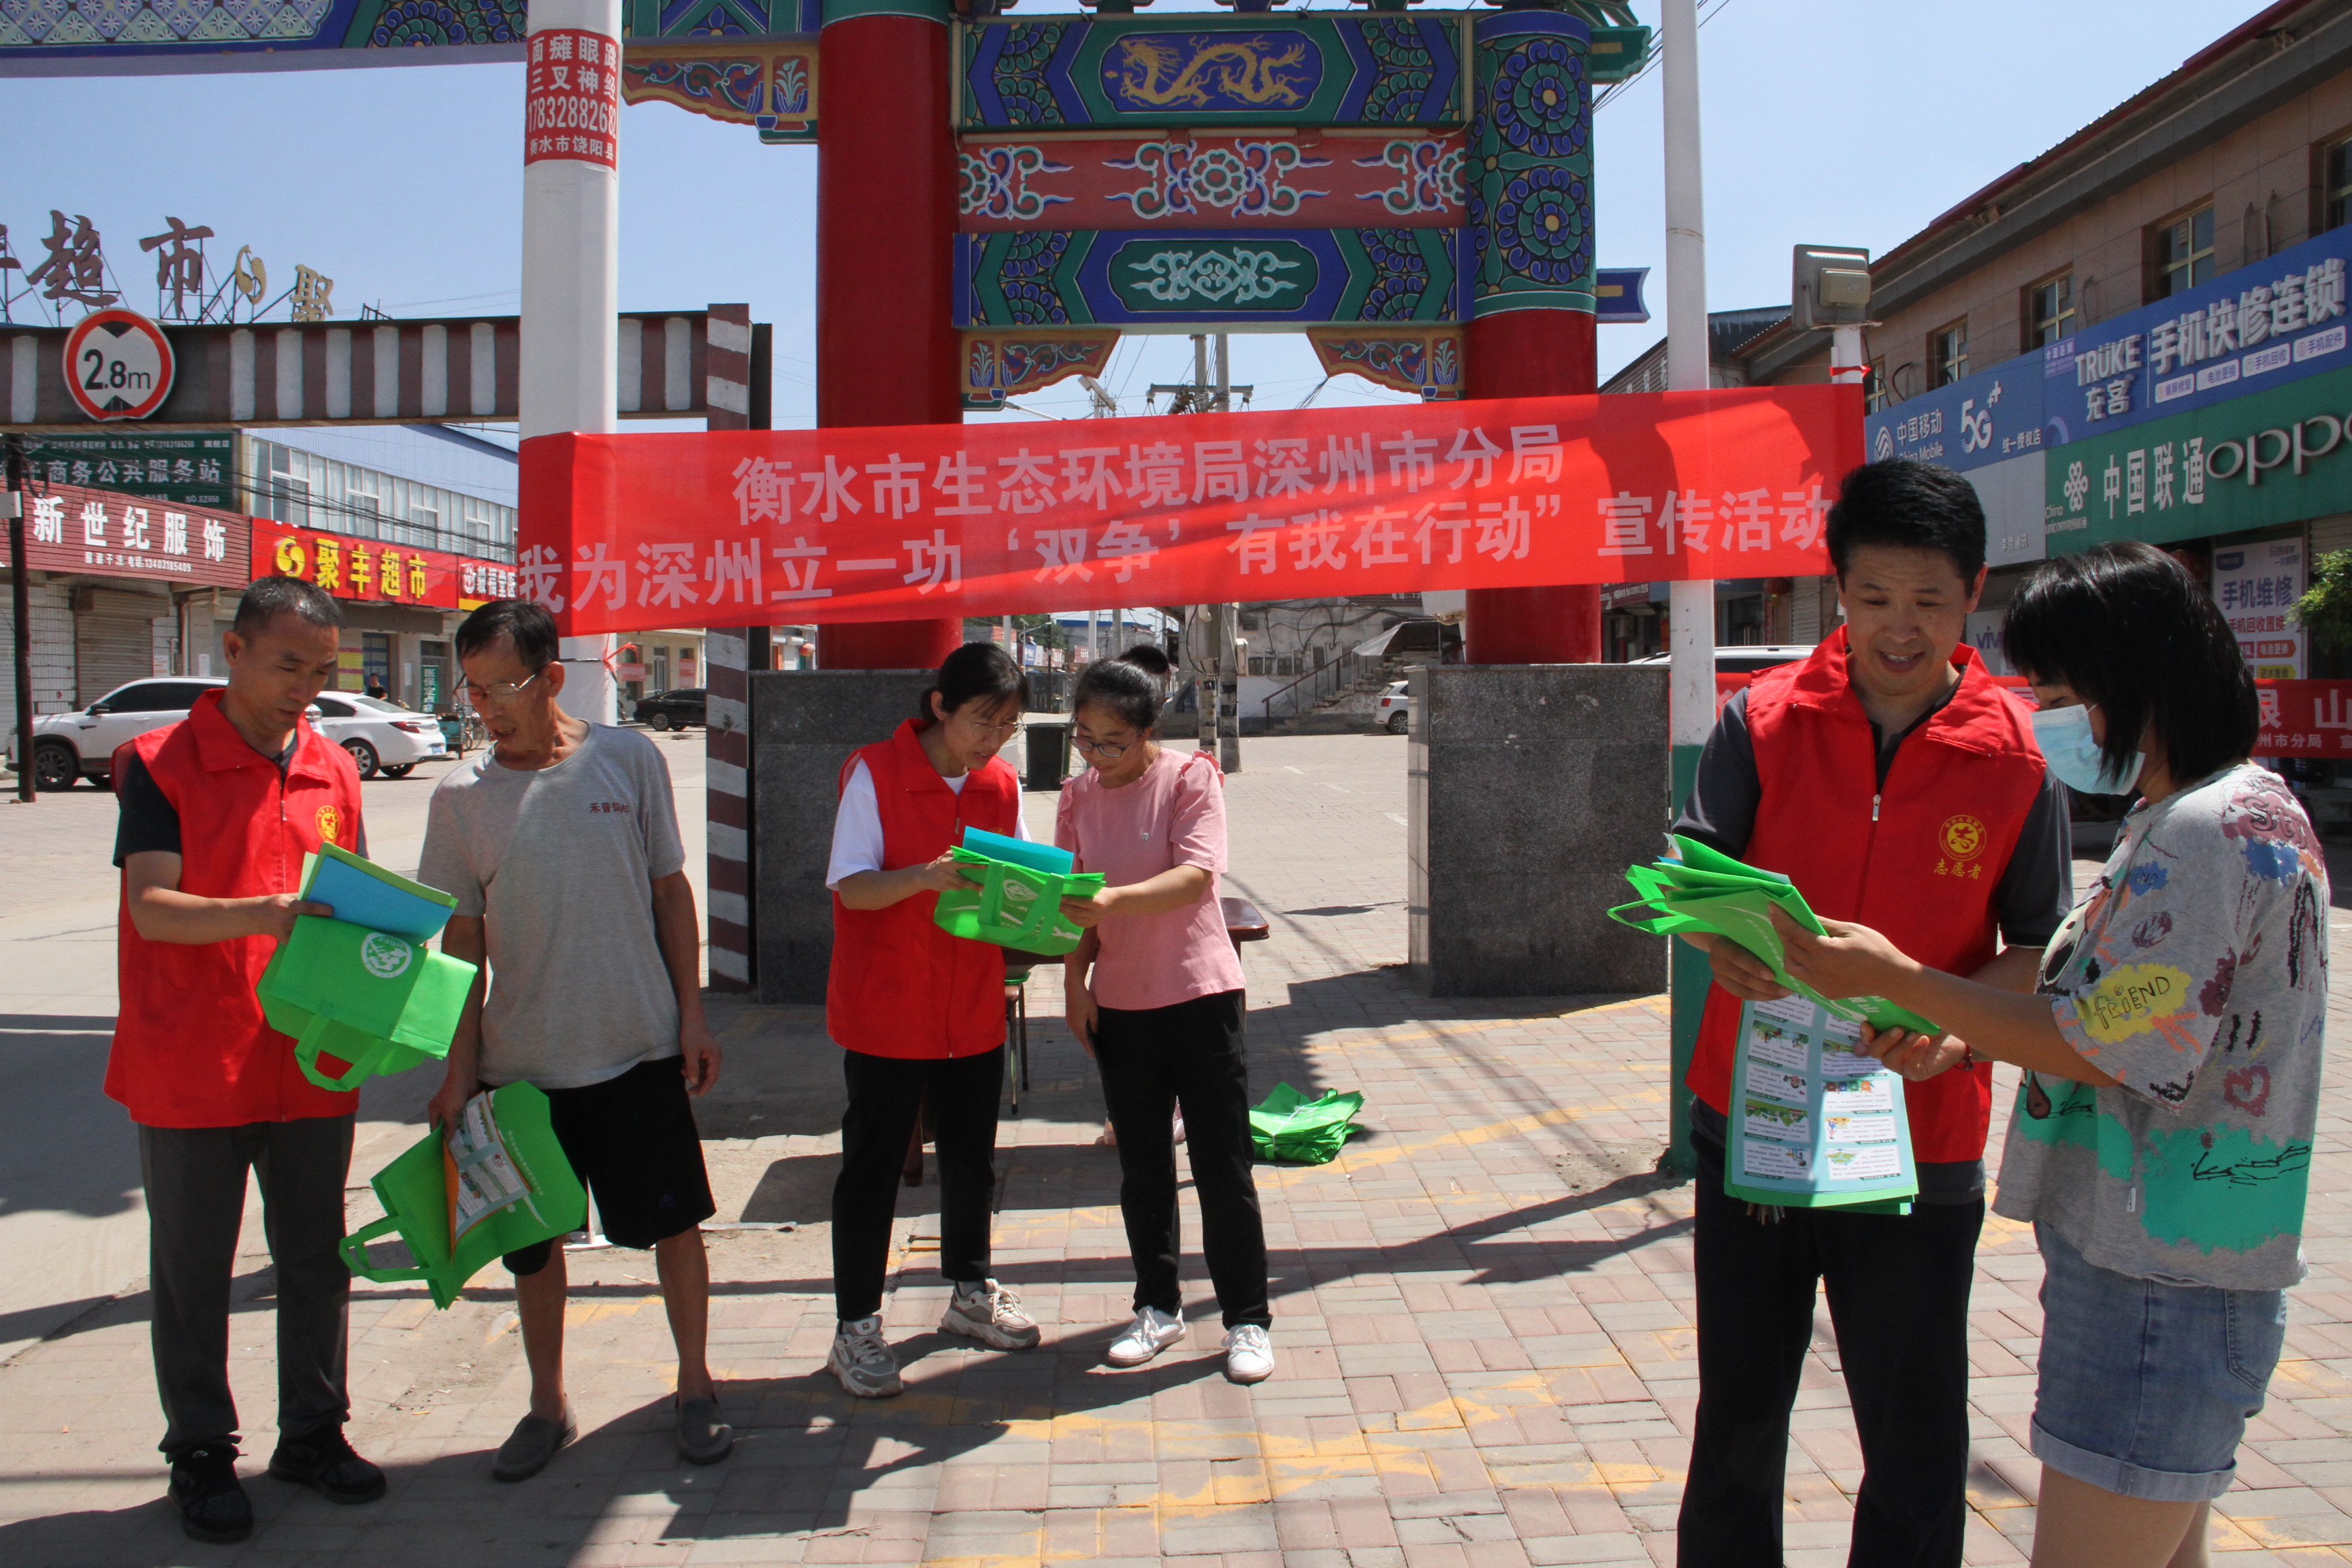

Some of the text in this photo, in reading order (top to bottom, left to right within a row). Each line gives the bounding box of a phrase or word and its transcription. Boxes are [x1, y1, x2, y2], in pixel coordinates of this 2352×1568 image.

[530, 135, 614, 161] 衡水市饶阳县
[0, 210, 214, 320] 超市
[2151, 258, 2346, 374] 手机快修连锁
[84, 348, 151, 390] 2.8m
[1897, 408, 1943, 446] 中国移动
[2003, 427, 2041, 453] 统一授权店
[2206, 415, 2352, 486] opp
[732, 423, 1564, 525] 衡水市生态环境局深州市分局
[2104, 436, 2204, 519] 中国联通
[33, 495, 227, 562] 新世纪服饰
[85, 551, 124, 566] 服装干洗
[519, 529, 962, 615] 我为深州立一功
[1597, 484, 1832, 557] 宣传活动
[316, 538, 427, 599] 聚丰超市
[2222, 575, 2294, 610] 手机维修
[1934, 858, 1982, 880] 志愿者
